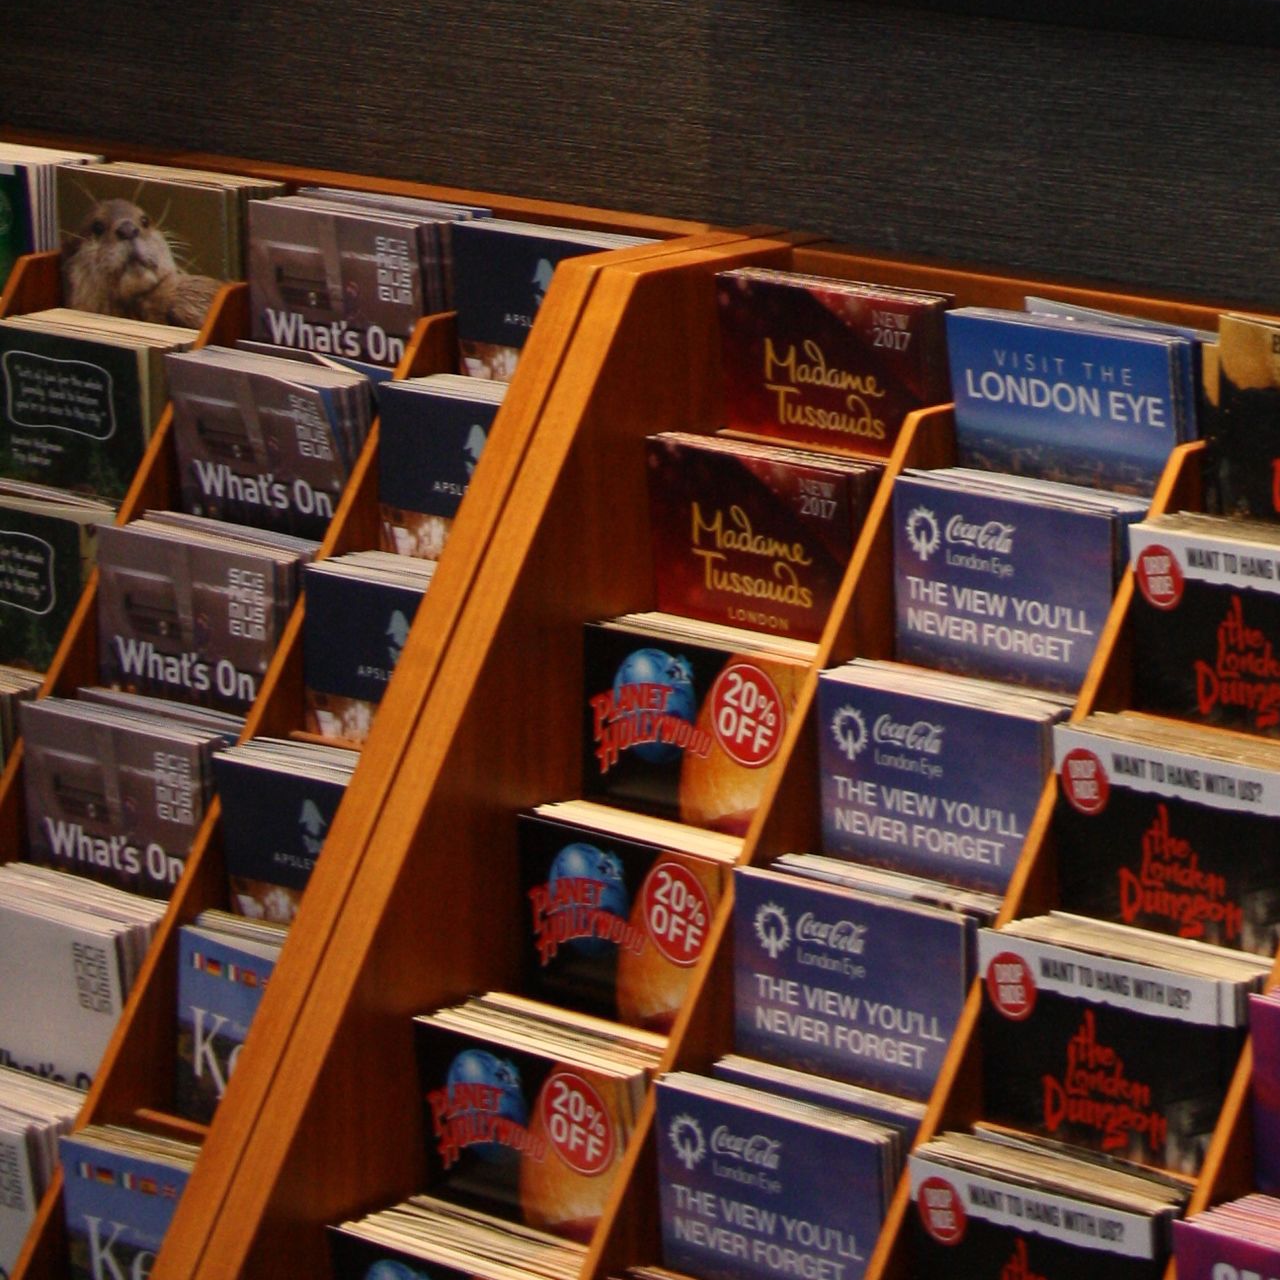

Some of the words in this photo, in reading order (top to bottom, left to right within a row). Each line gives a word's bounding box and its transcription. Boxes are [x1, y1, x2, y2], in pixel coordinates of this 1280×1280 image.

[265, 309, 360, 358] What's
[366, 325, 405, 363] On
[872, 310, 909, 331] NEW
[874, 328, 911, 352] 2017
[764, 338, 885, 397] Madame
[993, 349, 1064, 376] VISIT
[1083, 362, 1133, 387] THE
[764, 382, 886, 440] Tussauds
[966, 368, 1100, 418] LONDON
[1109, 391, 1166, 428] EYE
[194, 460, 289, 509] What's
[294, 480, 334, 518] On
[799, 478, 835, 498] NEW
[801, 496, 837, 520] 2017
[691, 502, 812, 566] Madame
[1185, 547, 1220, 570] WANT
[1222, 553, 1239, 574] TO
[1239, 556, 1273, 579] HANG
[692, 548, 813, 609] Tussauds
[946, 549, 990, 574] London
[991, 556, 1015, 579] Eye
[728, 607, 789, 631] LONDON
[907, 575, 948, 606] THE
[953, 585, 1007, 618] VIEW
[1011, 598, 1094, 635] YOU'LL
[907, 608, 977, 645] NEVER
[983, 623, 1074, 663] FORGET
[115, 635, 209, 692] What's
[217, 660, 257, 701] On
[589, 683, 675, 742] PLANET
[724, 672, 776, 726] 20%
[595, 715, 713, 773] HOLLYWOOD
[719, 706, 773, 753] OFF
[874, 749, 920, 773] London
[920, 757, 943, 780] Eye
[1112, 753, 1146, 778] WANT
[1149, 761, 1165, 783] TO
[1166, 764, 1201, 790] HANG
[1203, 772, 1236, 797] WITH
[833, 775, 877, 806] THE
[880, 785, 936, 819] VIEW
[941, 798, 1024, 838] YOU'LL
[46, 817, 139, 874] What's
[146, 843, 184, 883] On
[833, 807, 908, 845] NEVER
[912, 824, 1005, 865] FORGET
[1142, 832, 1226, 897] London
[528, 876, 607, 934] PLANET
[654, 870, 705, 926] 20%
[1118, 865, 1243, 939] Dungeon
[535, 907, 645, 966] HOLLYWOOD
[651, 904, 702, 952] OFF
[754, 973, 799, 1005] THE
[802, 984, 859, 1020] VIEW
[863, 999, 945, 1043] YOU'LL
[1039, 957, 1074, 983] WANT
[1078, 965, 1094, 988] TO
[1095, 969, 1130, 996] HANG
[1133, 977, 1164, 1003] WITH
[756, 1005, 829, 1046] NEVER
[834, 1024, 926, 1070] FORGET
[1066, 1037, 1151, 1106] London
[427, 1083, 505, 1138] PLANET
[549, 1114, 603, 1161] OFF
[552, 1081, 605, 1137] 20%
[1042, 1075, 1168, 1149] Dungeon
[437, 1114, 546, 1170] HOLLYWOOD
[671, 1183, 717, 1218] THE
[720, 1197, 777, 1235] VIEW
[780, 1215, 865, 1261] YOU'LL
[673, 1216, 749, 1260] NEVER
[752, 1240, 845, 1280] FORGET
